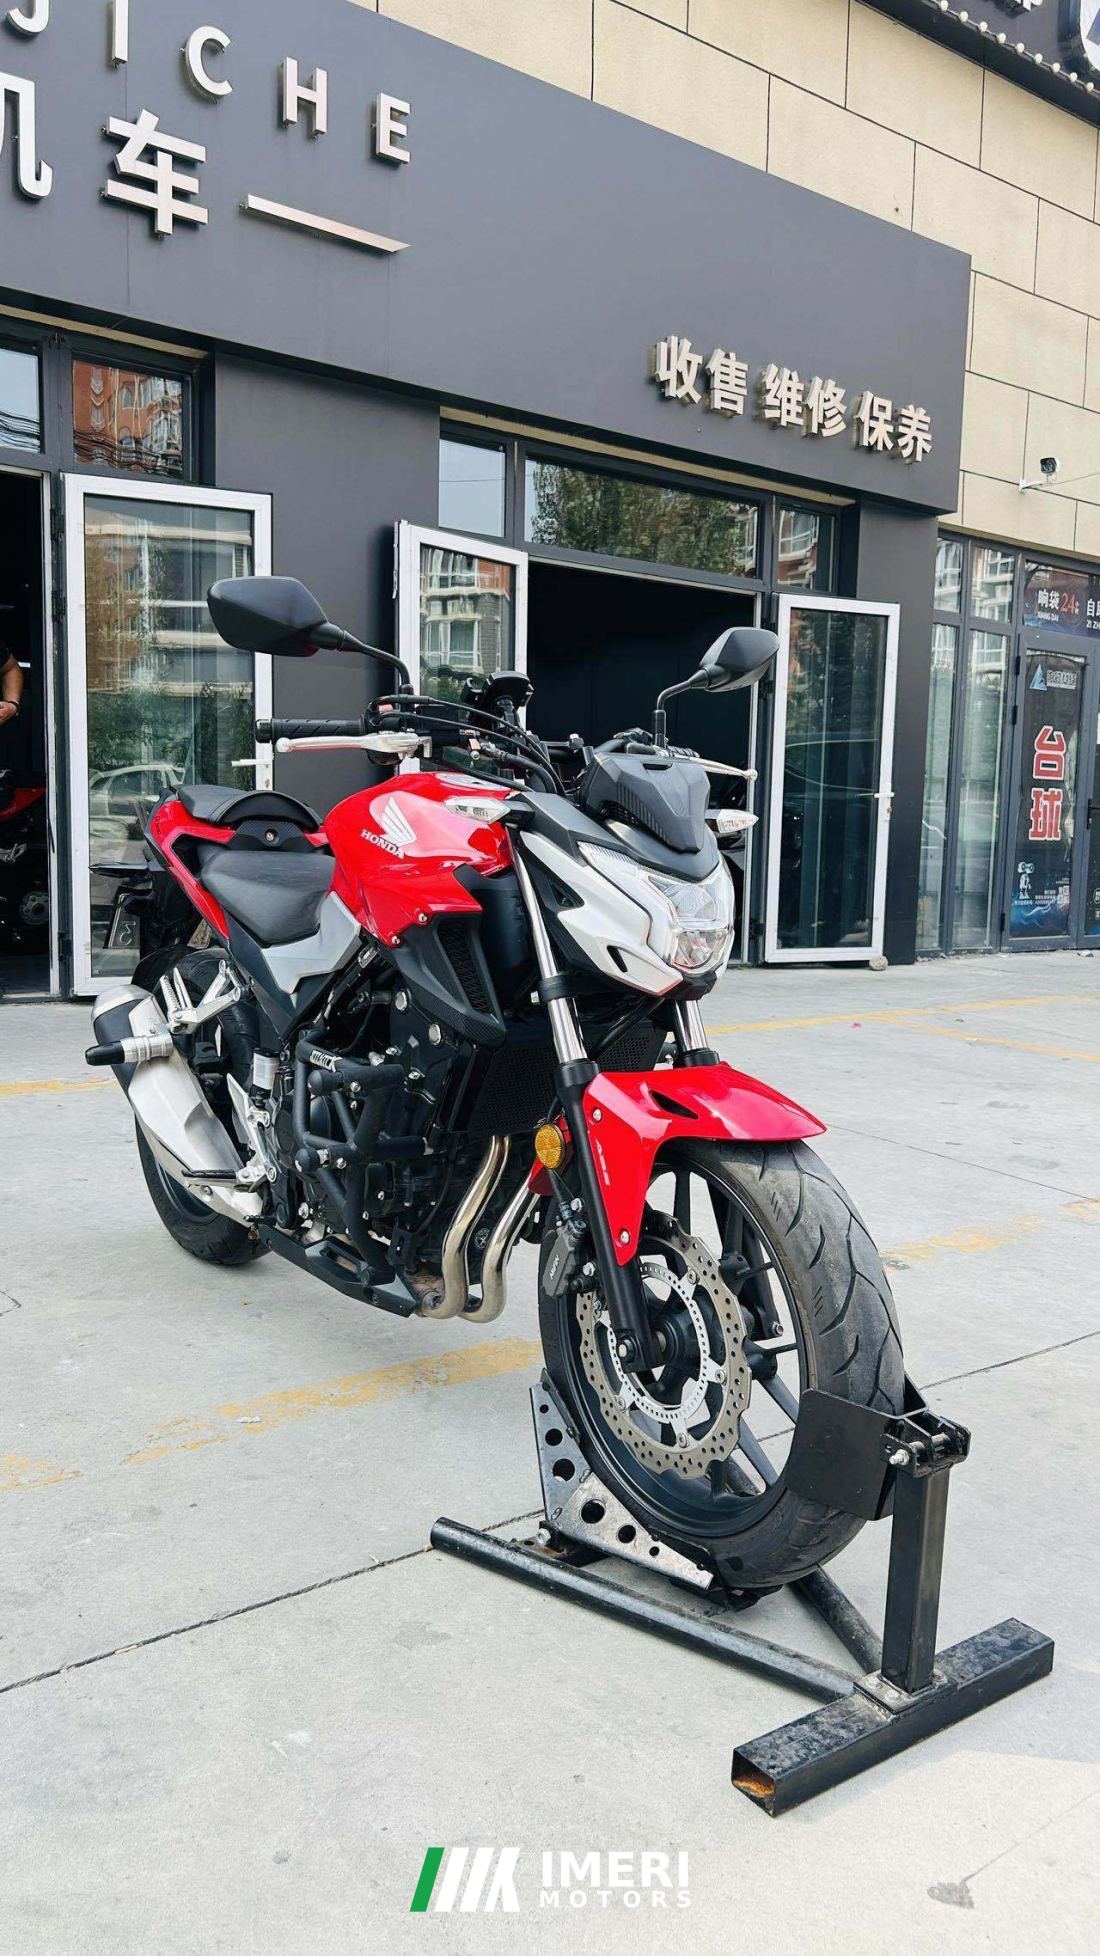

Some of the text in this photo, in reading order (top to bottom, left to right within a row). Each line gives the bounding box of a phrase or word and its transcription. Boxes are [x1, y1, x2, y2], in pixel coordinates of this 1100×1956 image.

[655, 335, 932, 463] 收售 维修 保养
[1029, 725, 1066, 840] 台球
[360, 829, 405, 860] HONDA
